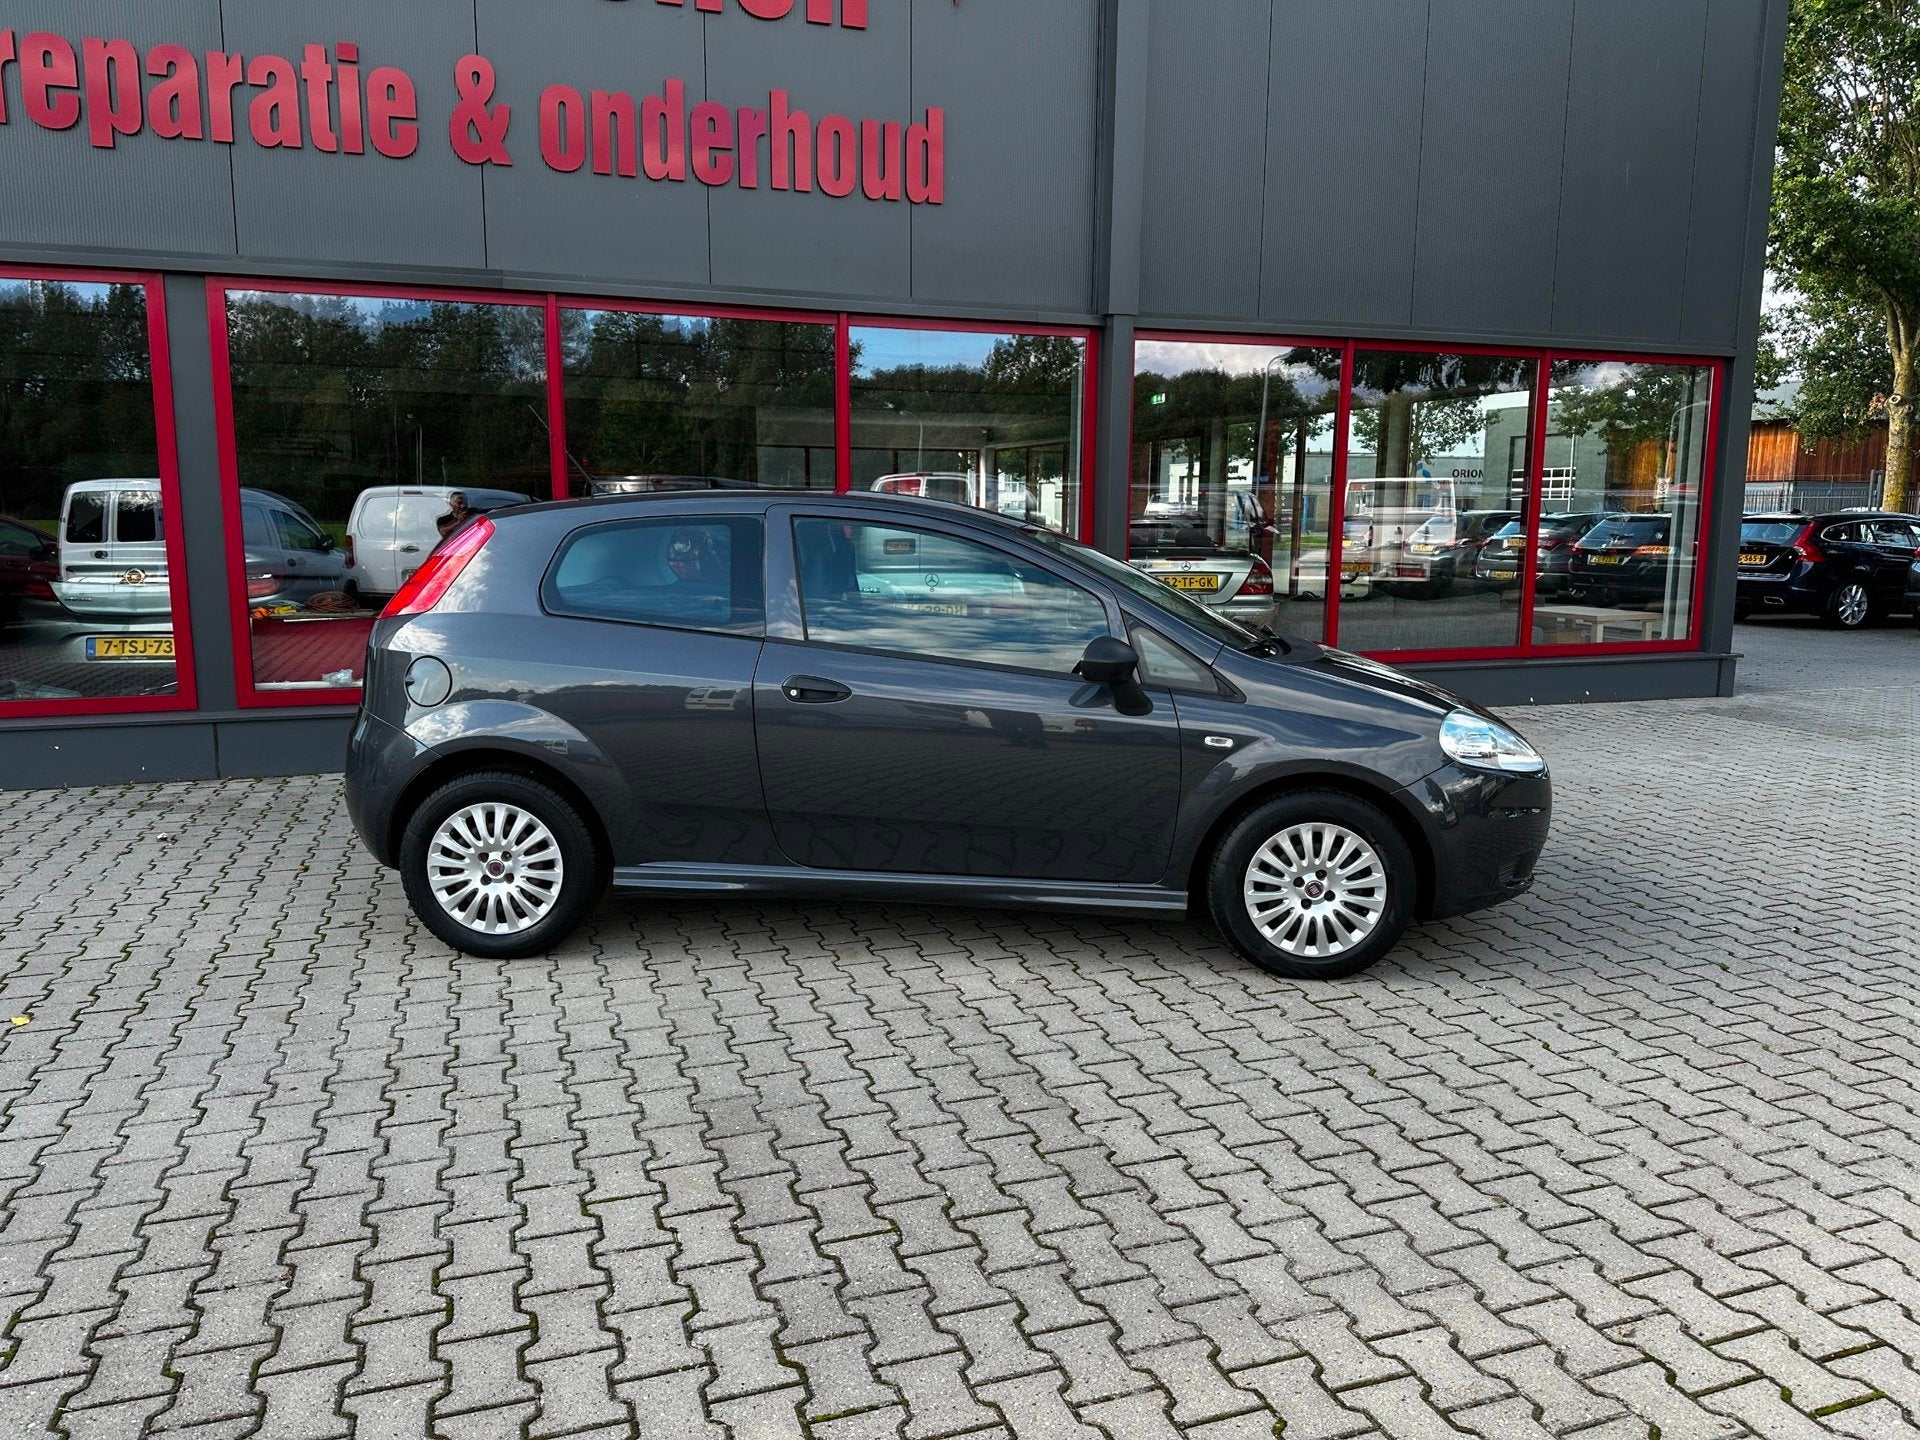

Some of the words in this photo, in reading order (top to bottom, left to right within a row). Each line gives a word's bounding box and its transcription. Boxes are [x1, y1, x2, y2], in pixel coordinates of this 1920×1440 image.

[450, 54, 511, 165] &
[540, 79, 943, 203] onderhoud
[103, 640, 173, 654] 7-TSJ-73
